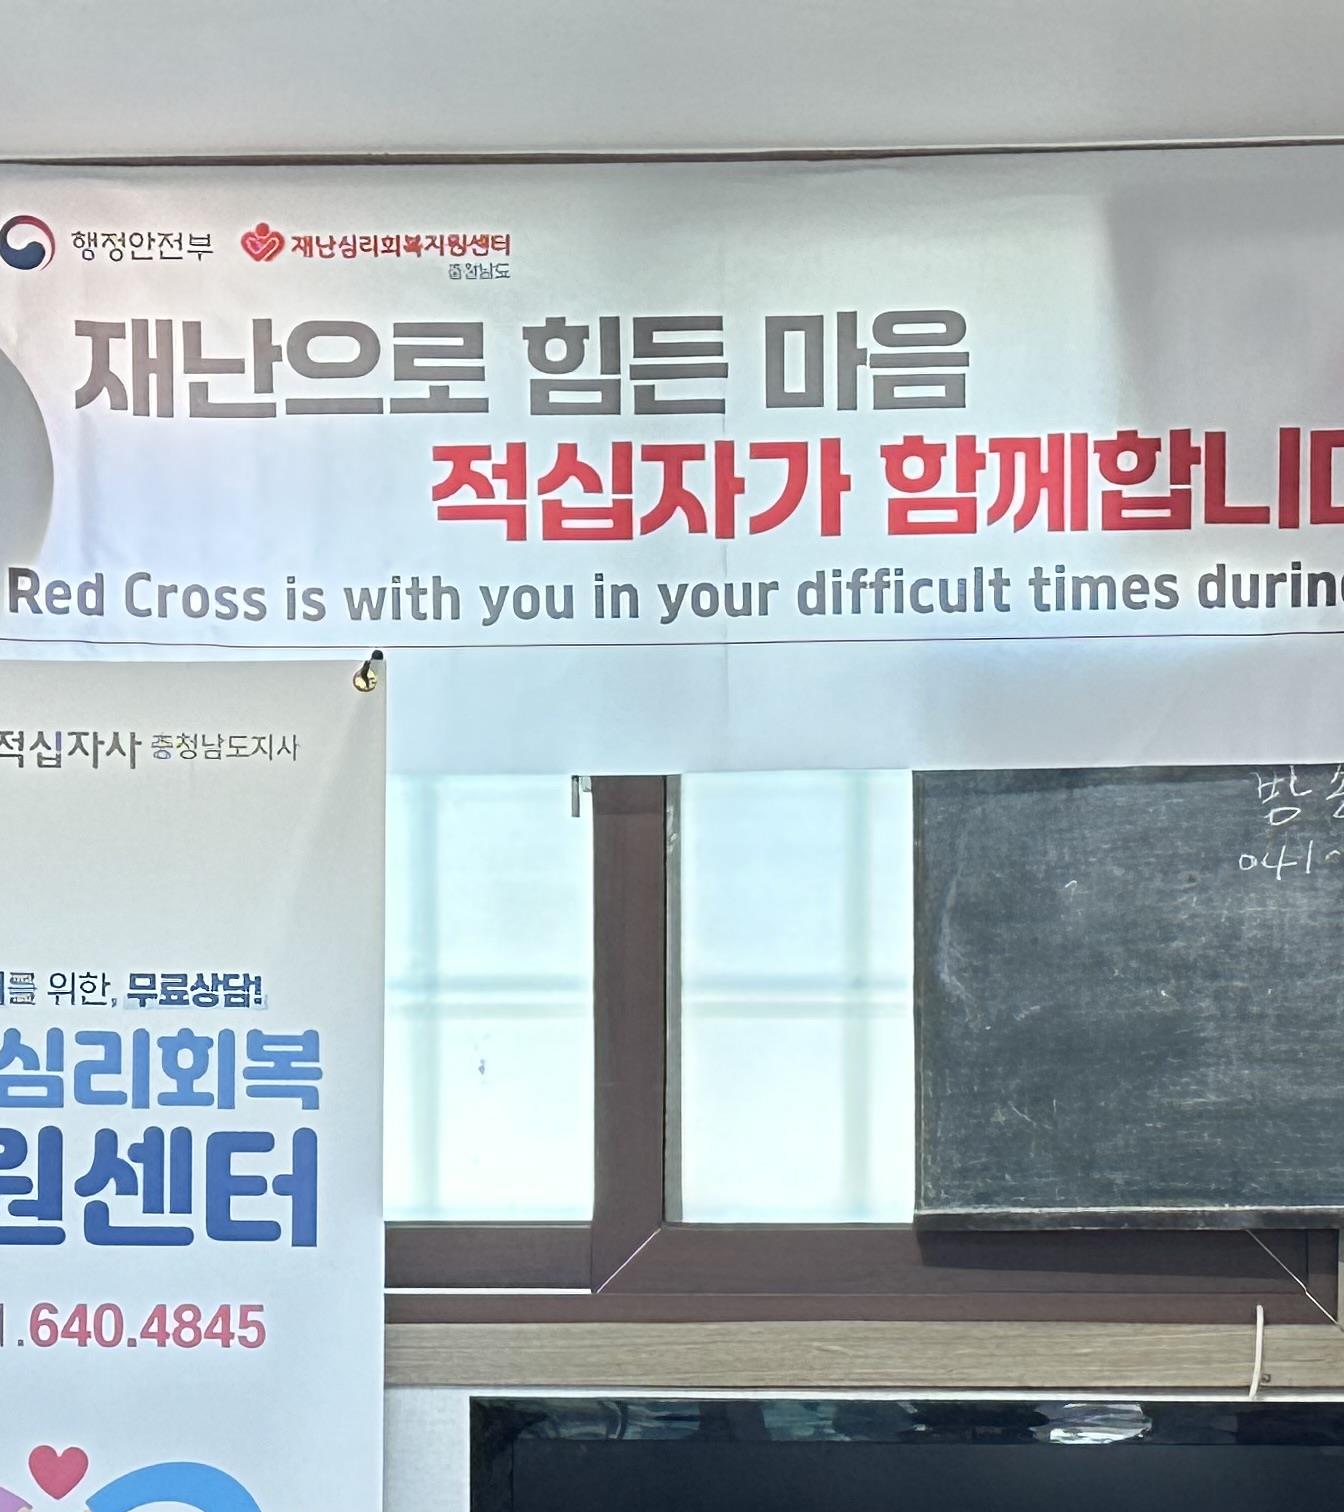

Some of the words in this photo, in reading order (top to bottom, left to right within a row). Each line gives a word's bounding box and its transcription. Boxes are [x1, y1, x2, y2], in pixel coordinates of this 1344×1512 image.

[71, 230, 214, 261] 행정안전부
[291, 233, 510, 258] 재난심리회복지원센터
[75, 317, 490, 418] 재난으로
[522, 315, 728, 415] 힘든
[765, 309, 969, 411] 마음
[432, 437, 851, 541] 적십자가
[8, 568, 104, 617] Red
[124, 572, 266, 621] Cross
[286, 575, 325, 620] is
[344, 575, 459, 621] with
[479, 581, 573, 627] you
[595, 573, 639, 619] in
[659, 578, 779, 625] your
[798, 566, 1011, 616] difficult
[1030, 564, 1179, 612] times
[150, 732, 301, 762] 충청남도지사
[47, 971, 117, 1007] 위한,
[127, 972, 262, 1009] 무료상담!
